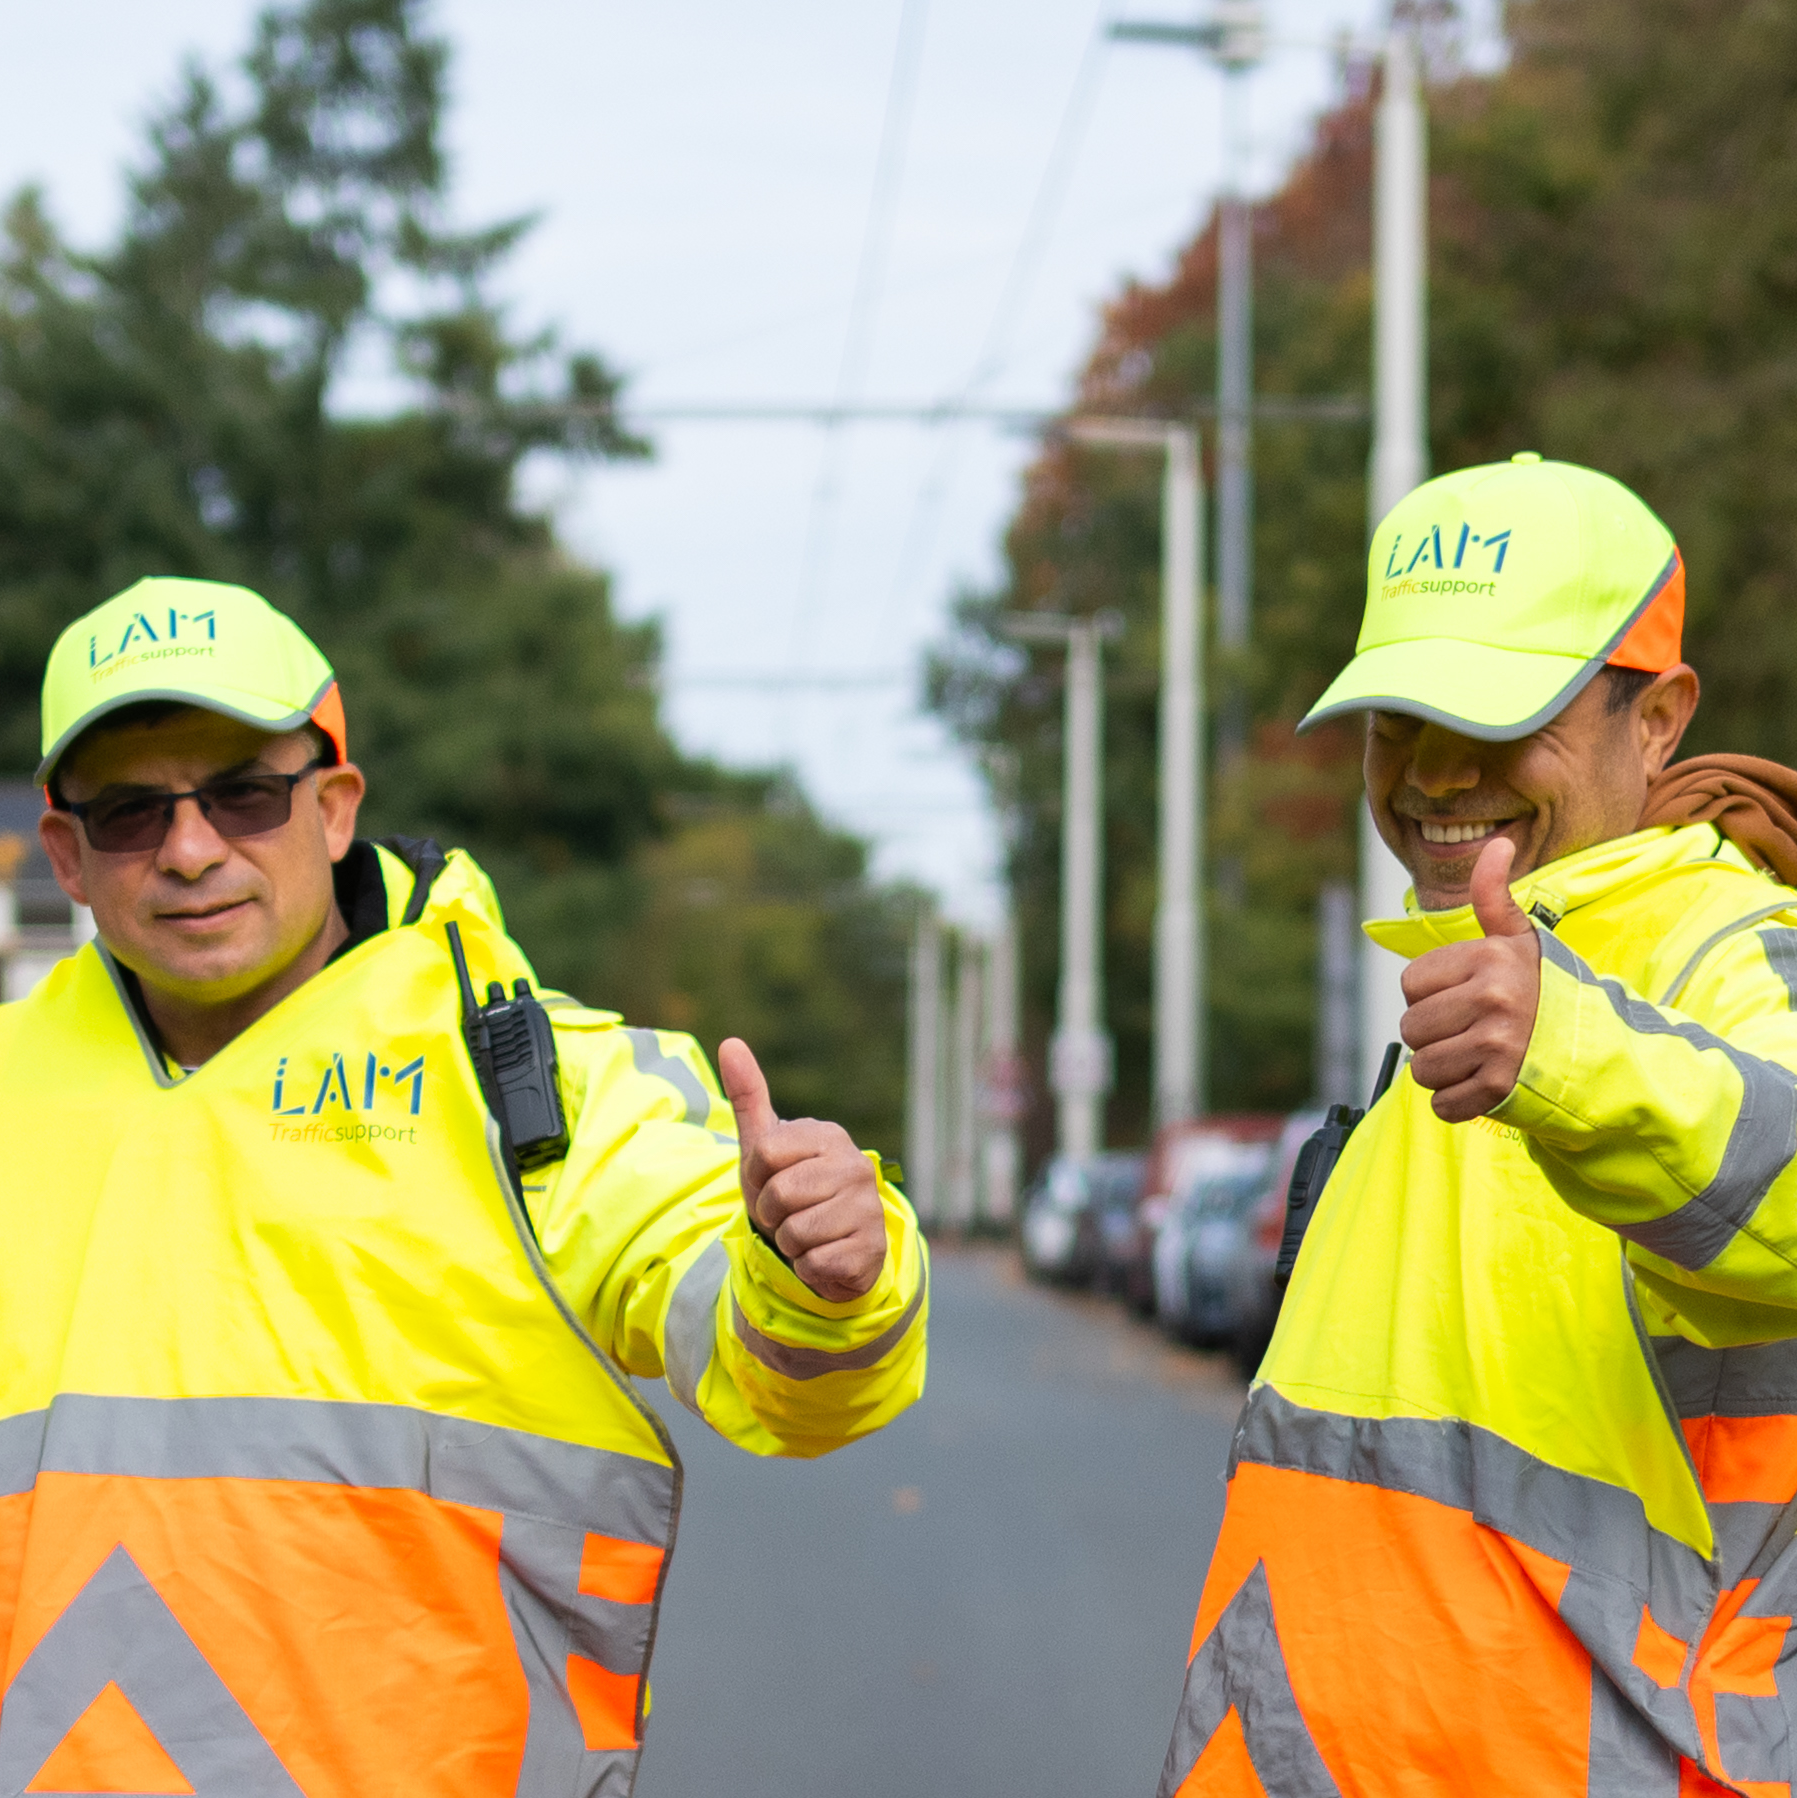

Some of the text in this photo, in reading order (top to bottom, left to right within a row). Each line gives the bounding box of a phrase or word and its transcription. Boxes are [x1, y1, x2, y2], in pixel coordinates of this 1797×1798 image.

[1385, 521, 1512, 580] LAM
[1381, 579, 1496, 602] Trafficsupport
[90, 607, 216, 669] LAM
[90, 646, 216, 684] Trafficsupport
[269, 1122, 417, 1144] Trafficsupport
